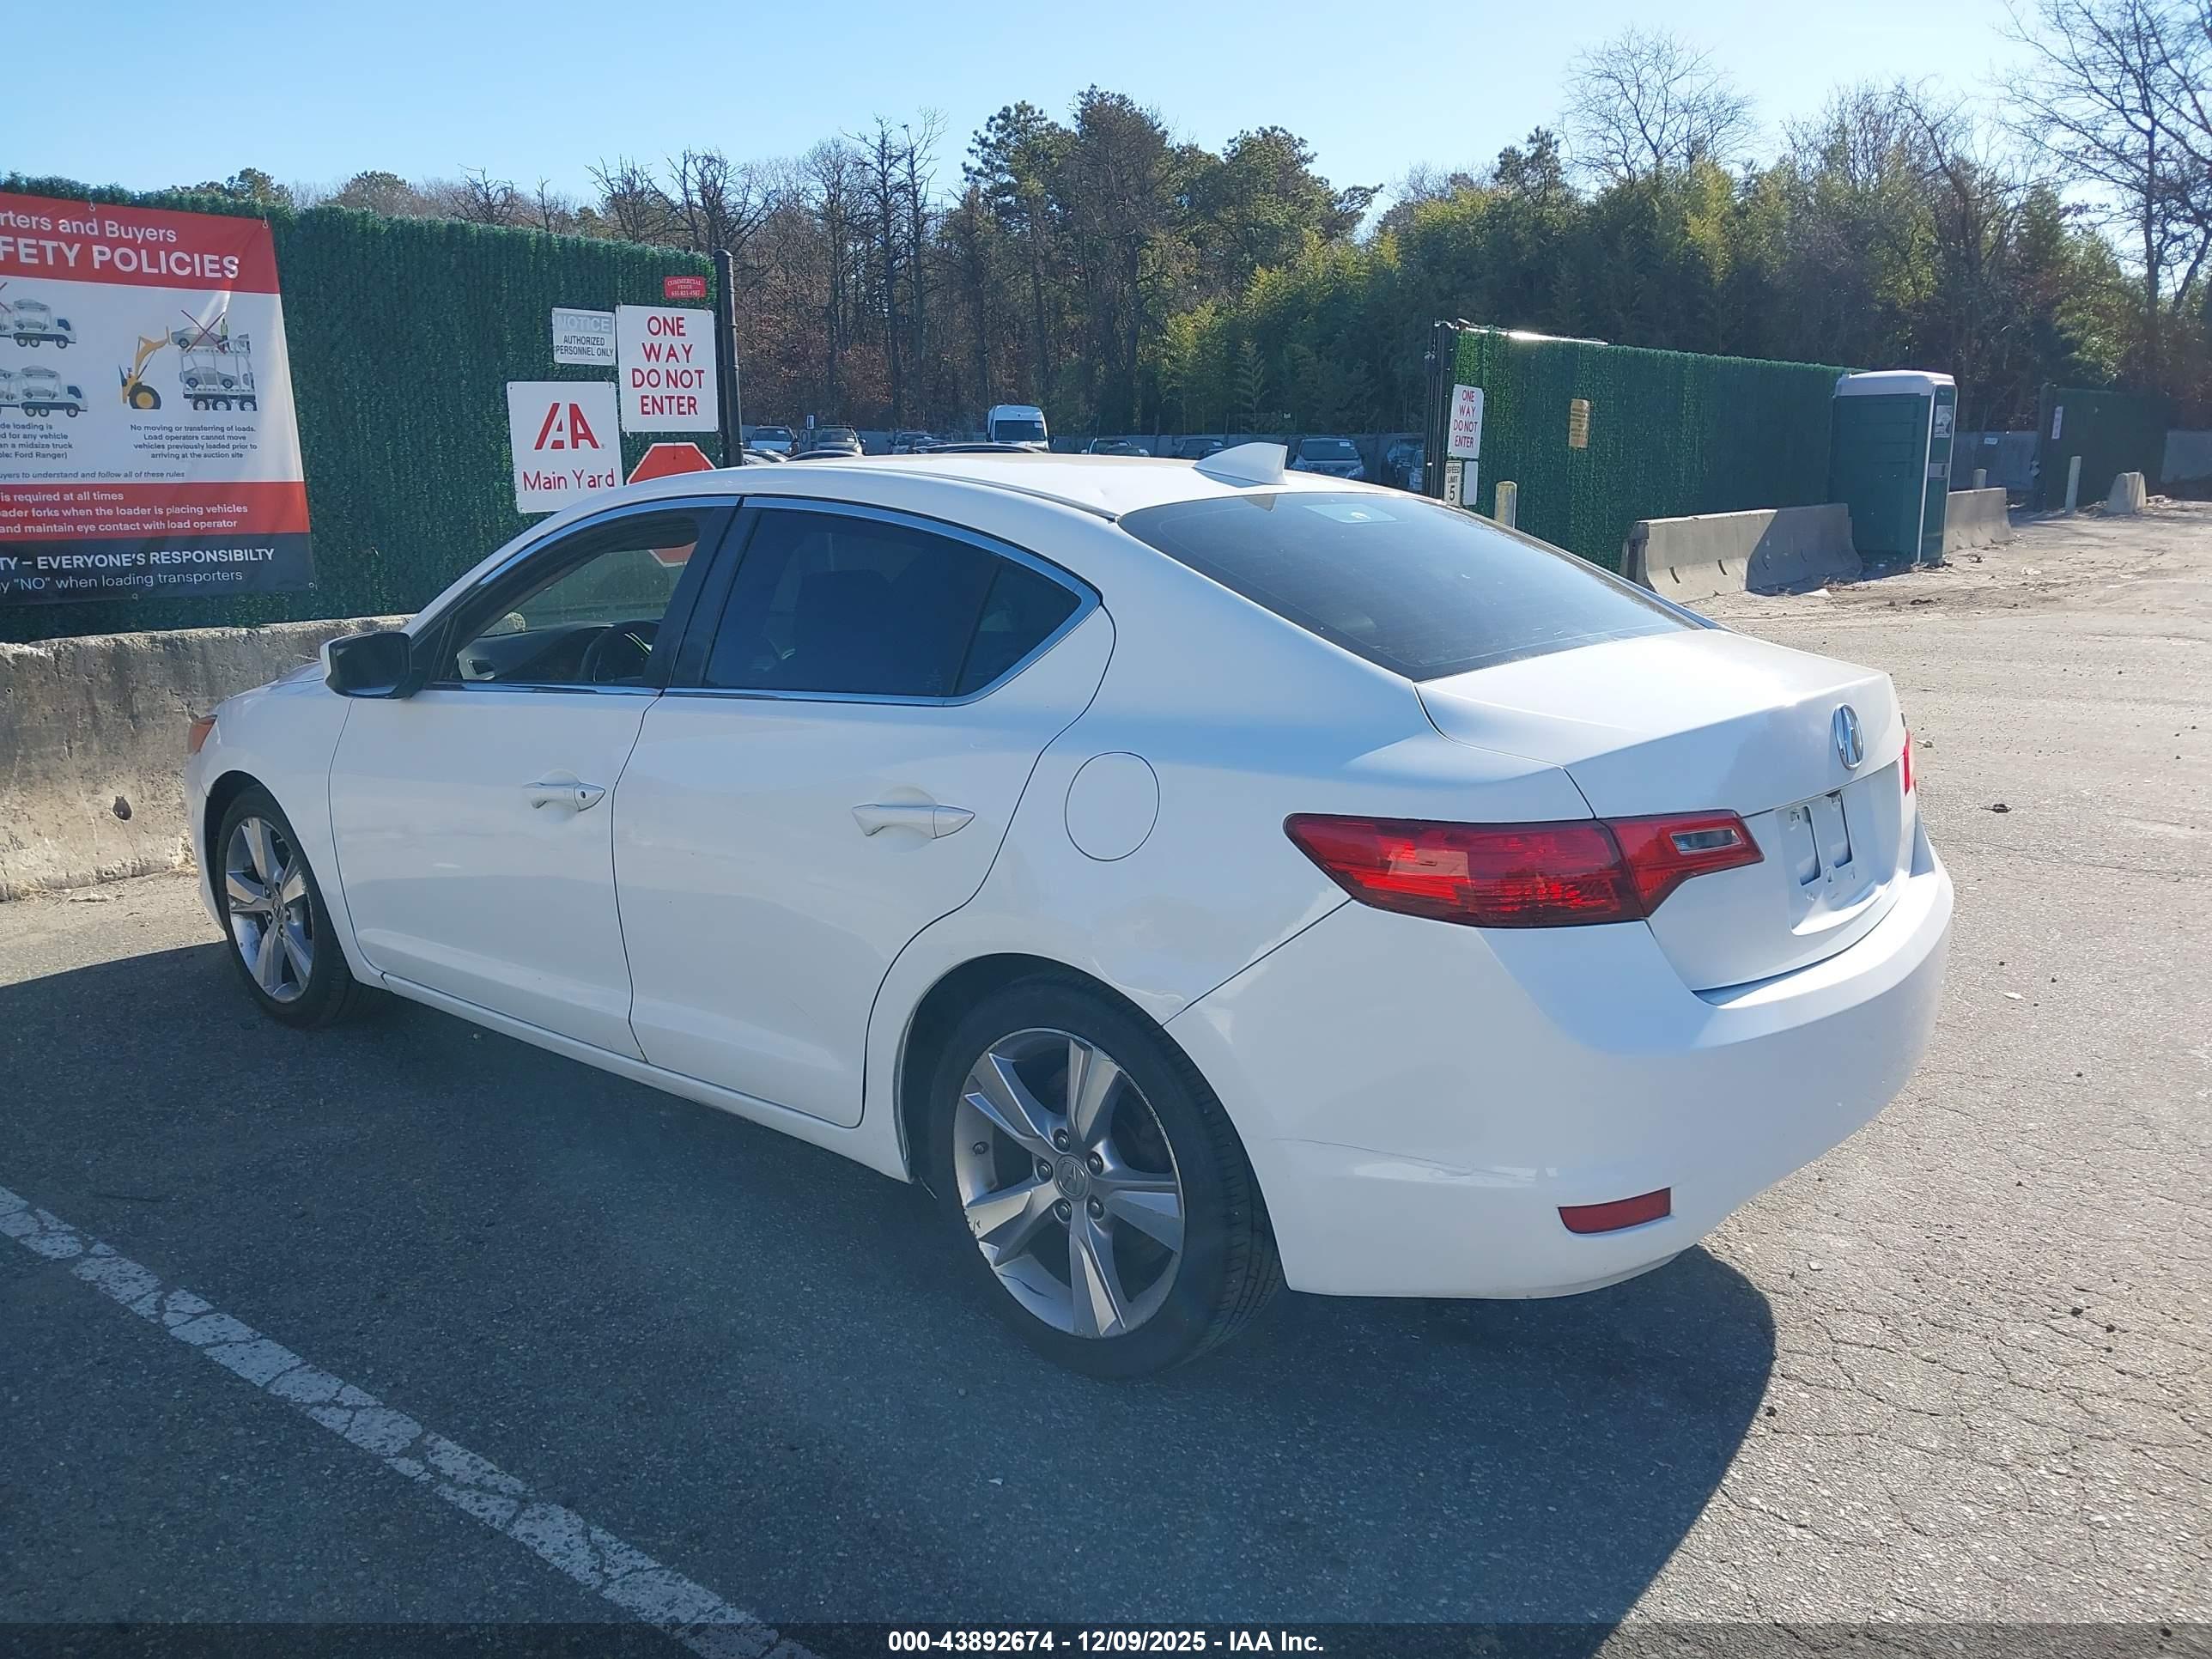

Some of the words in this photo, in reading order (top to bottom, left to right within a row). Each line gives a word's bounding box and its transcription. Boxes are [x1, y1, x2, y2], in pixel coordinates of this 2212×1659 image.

[58, 218, 99, 235] and
[105, 220, 177, 244] Buyers
[92, 245, 239, 279] POLICIES
[556, 316, 611, 332] NOTICE
[647, 316, 686, 337] ONE
[563, 335, 605, 346] AUTHORIZED
[556, 345, 595, 356] PERSONNEL
[596, 347, 614, 357] ONLY
[641, 343, 693, 363] WAY
[631, 368, 661, 388] DO
[665, 368, 705, 389] NOT
[1462, 390, 1475, 402] ONE
[641, 395, 698, 416] ENTER
[1459, 404, 1476, 417] WAY
[13, 422, 44, 431] loading
[143, 424, 173, 433] moving
[184, 424, 224, 433] transferring
[1453, 419, 1464, 431] DO
[1464, 420, 1478, 433] NOT
[1455, 435, 1474, 447] ENTER
[35, 451, 68, 460] Ranger)
[522, 471, 568, 492] Main
[572, 468, 616, 489] Yard
[1447, 475, 1459, 483] LIMIT
[14, 492, 60, 504] required
[63, 492, 74, 501] at
[76, 491, 90, 501] all
[92, 491, 124, 501] times
[1449, 485, 1455, 501] 5
[32, 507, 59, 517] forks
[61, 507, 93, 516] when
[95, 507, 113, 516] the
[116, 506, 152, 515] loader
[155, 505, 164, 514] is
[166, 505, 204, 516] placing
[206, 503, 248, 514] vehicles
[0, 524, 21, 533] and
[24, 523, 74, 533] maintain
[76, 524, 96, 534] eye
[99, 521, 141, 532] contact
[143, 520, 166, 530] with
[167, 520, 191, 529] load
[193, 520, 238, 530] operator
[37, 553, 146, 569] EVERYONE'S
[149, 548, 275, 565] RESPONSIBILTY
[56, 575, 98, 588] when
[102, 573, 154, 587] loading
[158, 571, 243, 585] transporters
